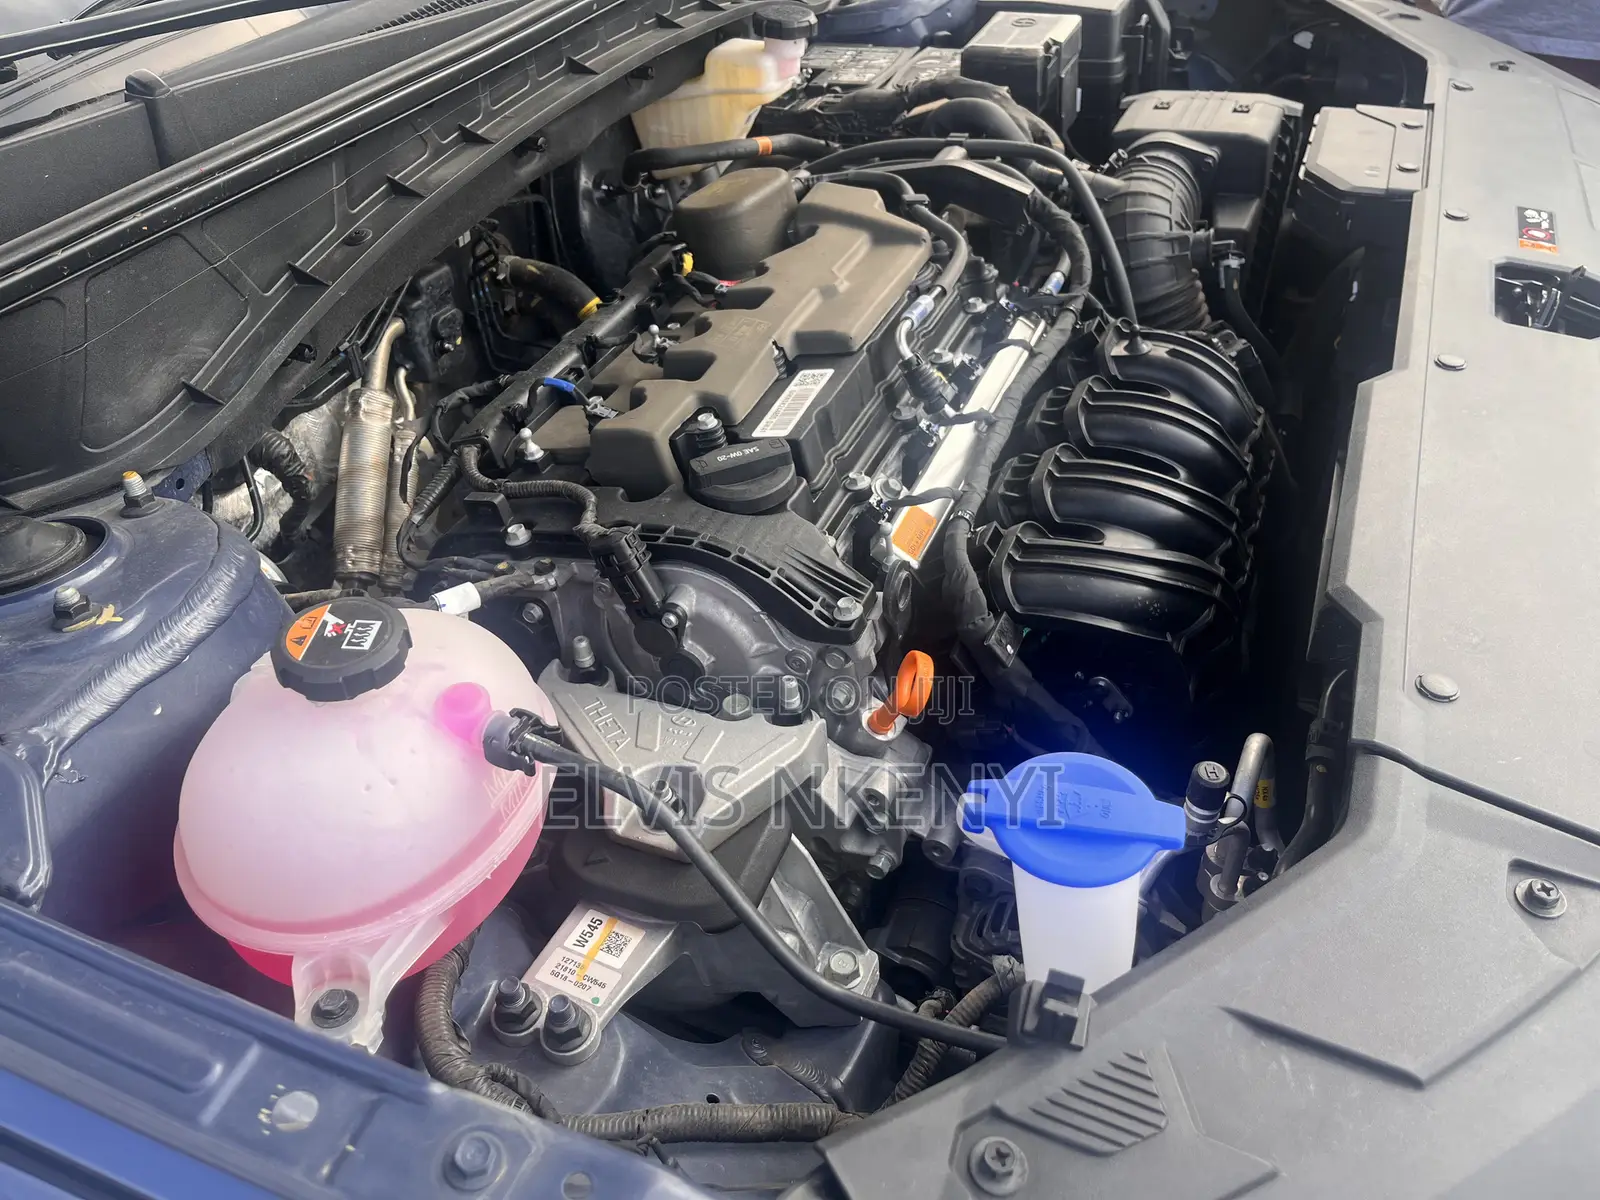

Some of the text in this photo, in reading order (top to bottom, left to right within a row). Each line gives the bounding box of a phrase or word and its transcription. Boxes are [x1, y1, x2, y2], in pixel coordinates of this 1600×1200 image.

[716, 446, 760, 462] SAE 0W-20
[583, 697, 632, 752] THETA
[573, 917, 603, 948] W545
